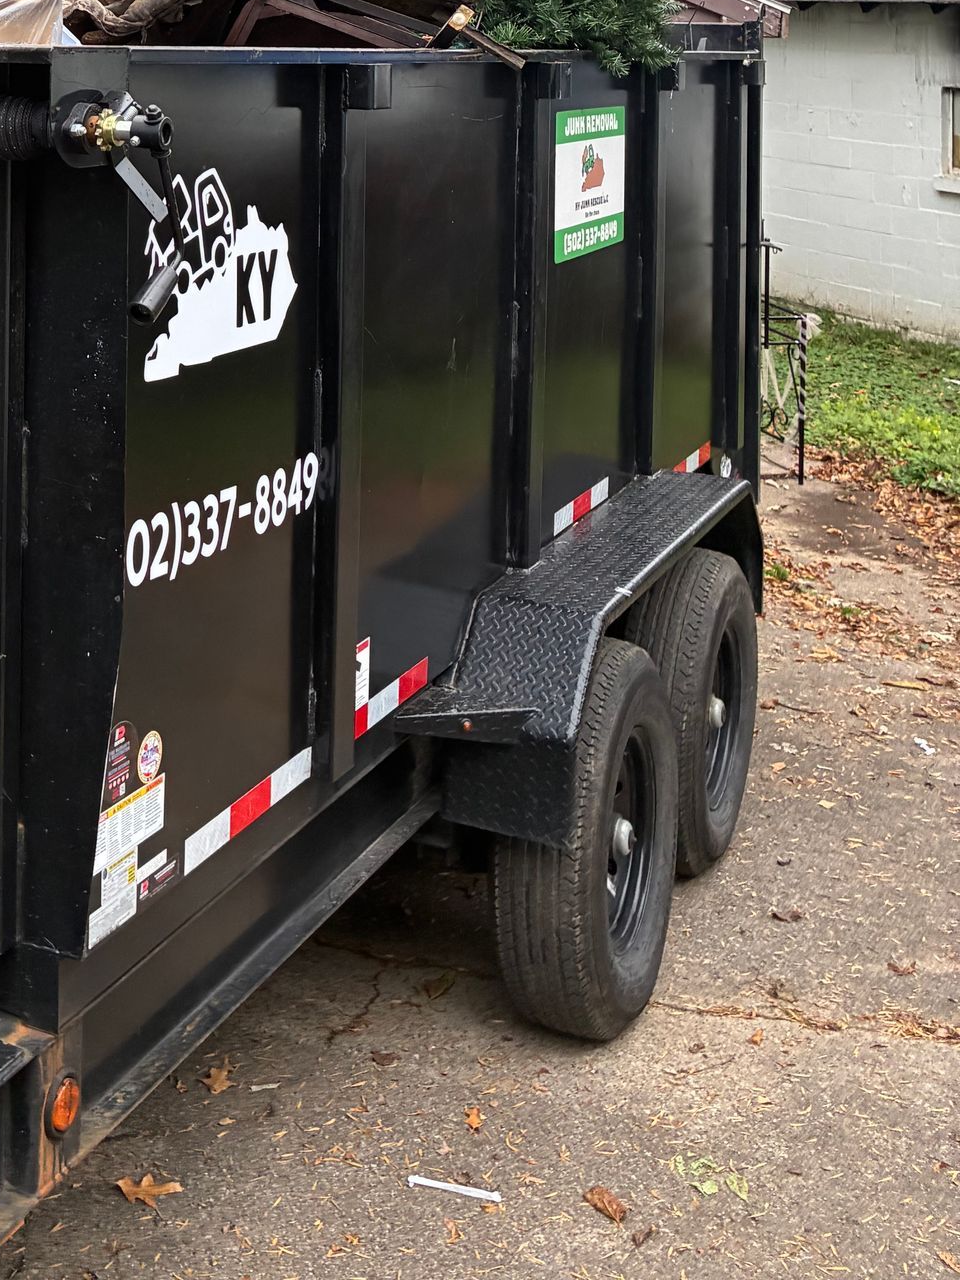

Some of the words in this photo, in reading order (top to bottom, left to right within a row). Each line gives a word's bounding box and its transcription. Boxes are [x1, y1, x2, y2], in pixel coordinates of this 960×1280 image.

[565, 117, 585, 136] JUNK
[586, 113, 618, 133] REMOVAL
[564, 228, 585, 256] (502)
[585, 219, 618, 247] 337-8849
[236, 248, 278, 328] KY
